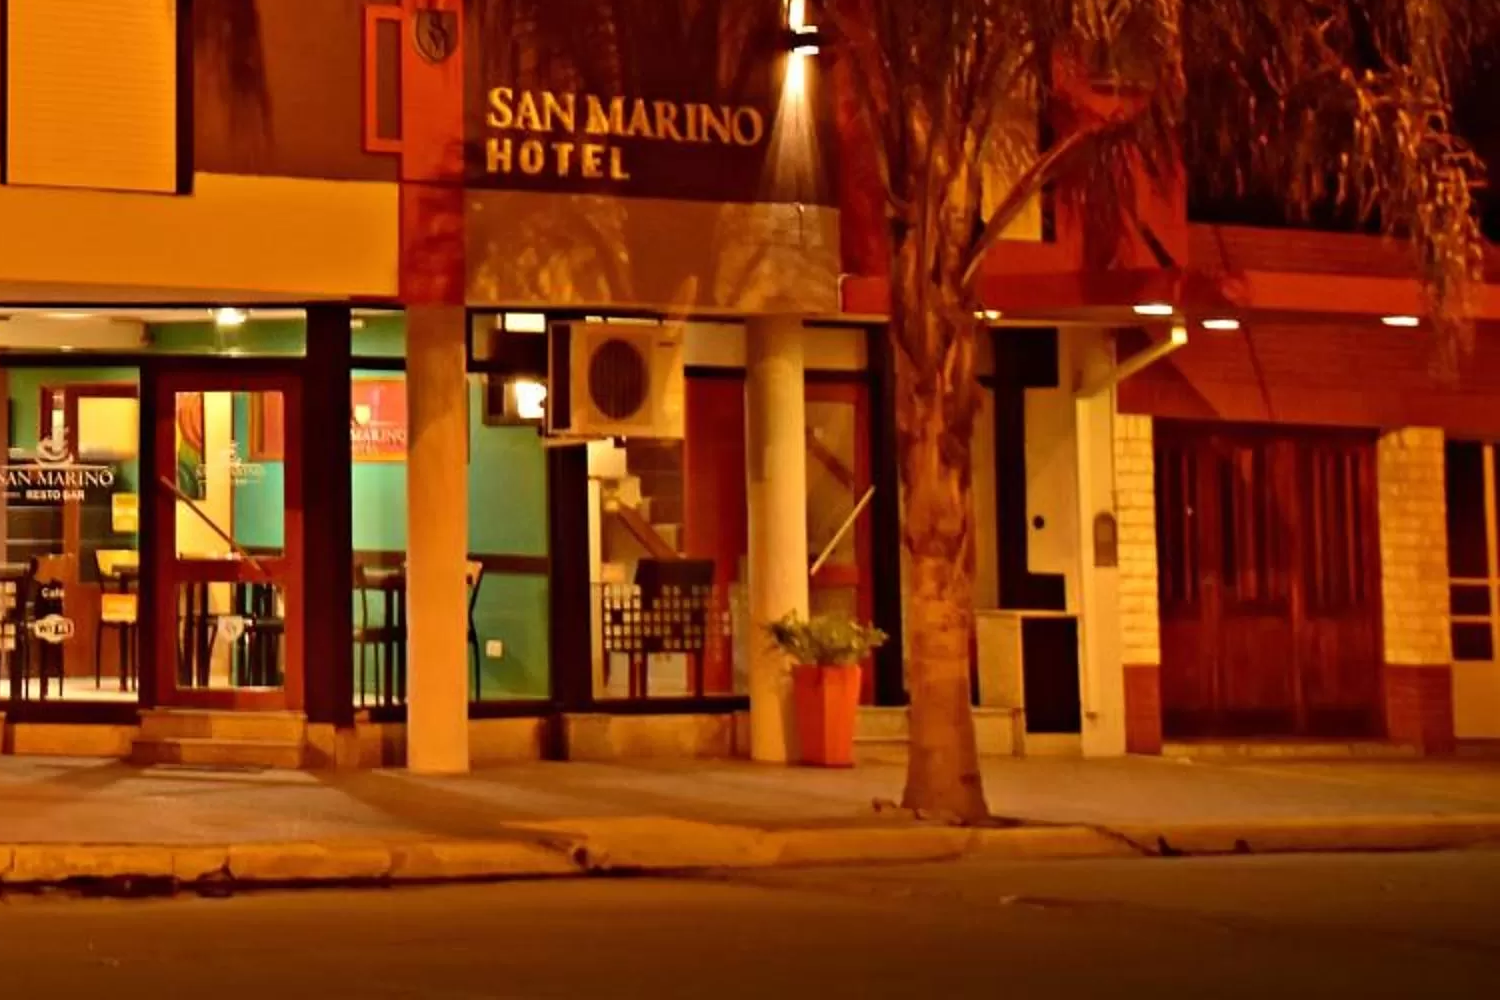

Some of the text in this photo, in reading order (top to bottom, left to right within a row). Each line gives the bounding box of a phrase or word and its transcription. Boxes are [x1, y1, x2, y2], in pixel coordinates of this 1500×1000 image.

[486, 86, 765, 146] SAN MARINO
[485, 138, 631, 180] HOTEL
[36, 470, 115, 488] MARINO
